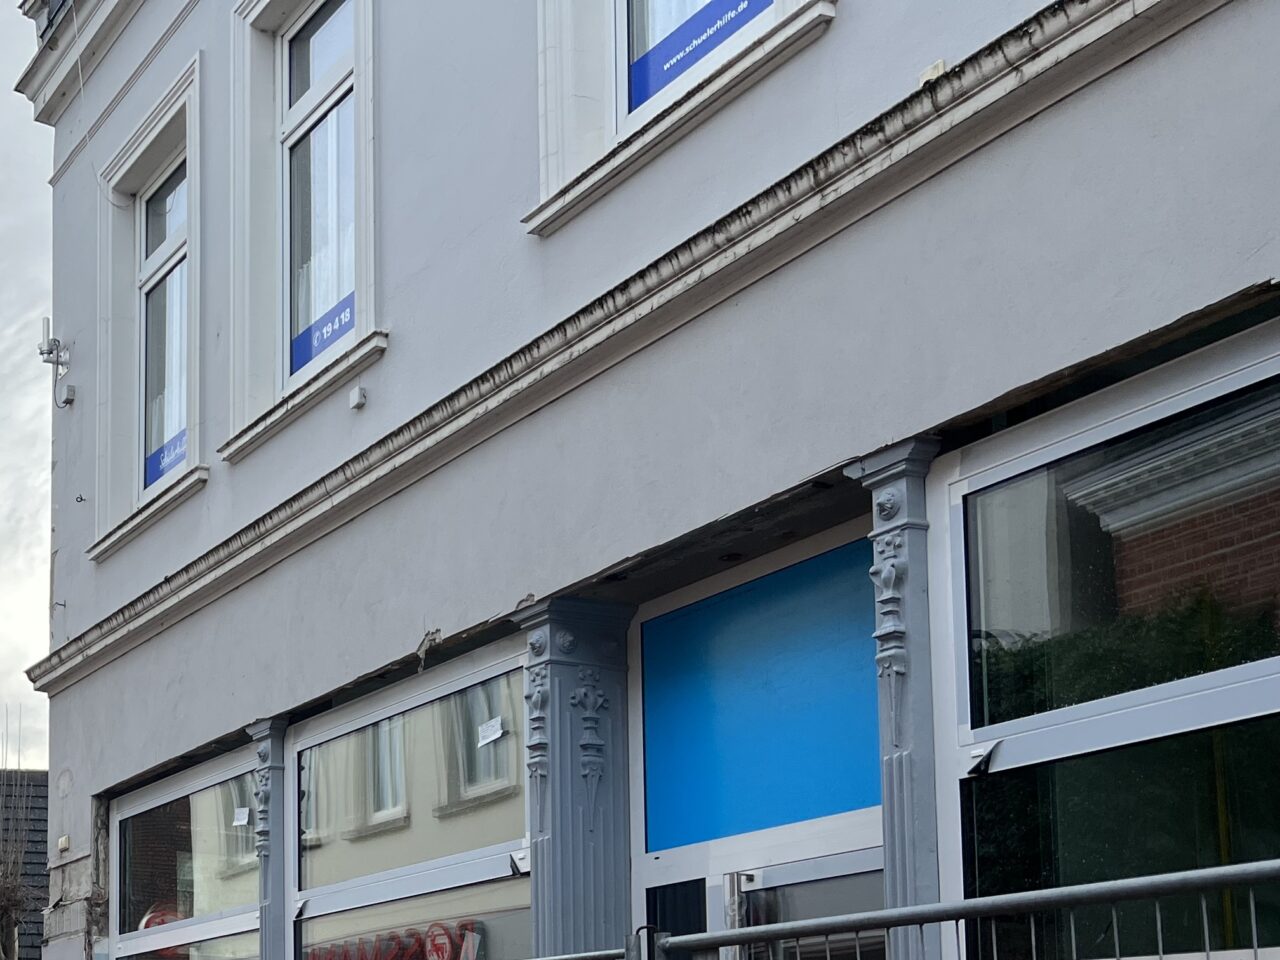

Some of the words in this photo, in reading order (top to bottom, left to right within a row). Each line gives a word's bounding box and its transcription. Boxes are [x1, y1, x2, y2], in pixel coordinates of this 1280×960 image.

[663, 0, 749, 71] www.schuelerhilfe.de
[322, 322, 333, 340] 19
[333, 316, 340, 330] 4
[340, 307, 351, 325] 18
